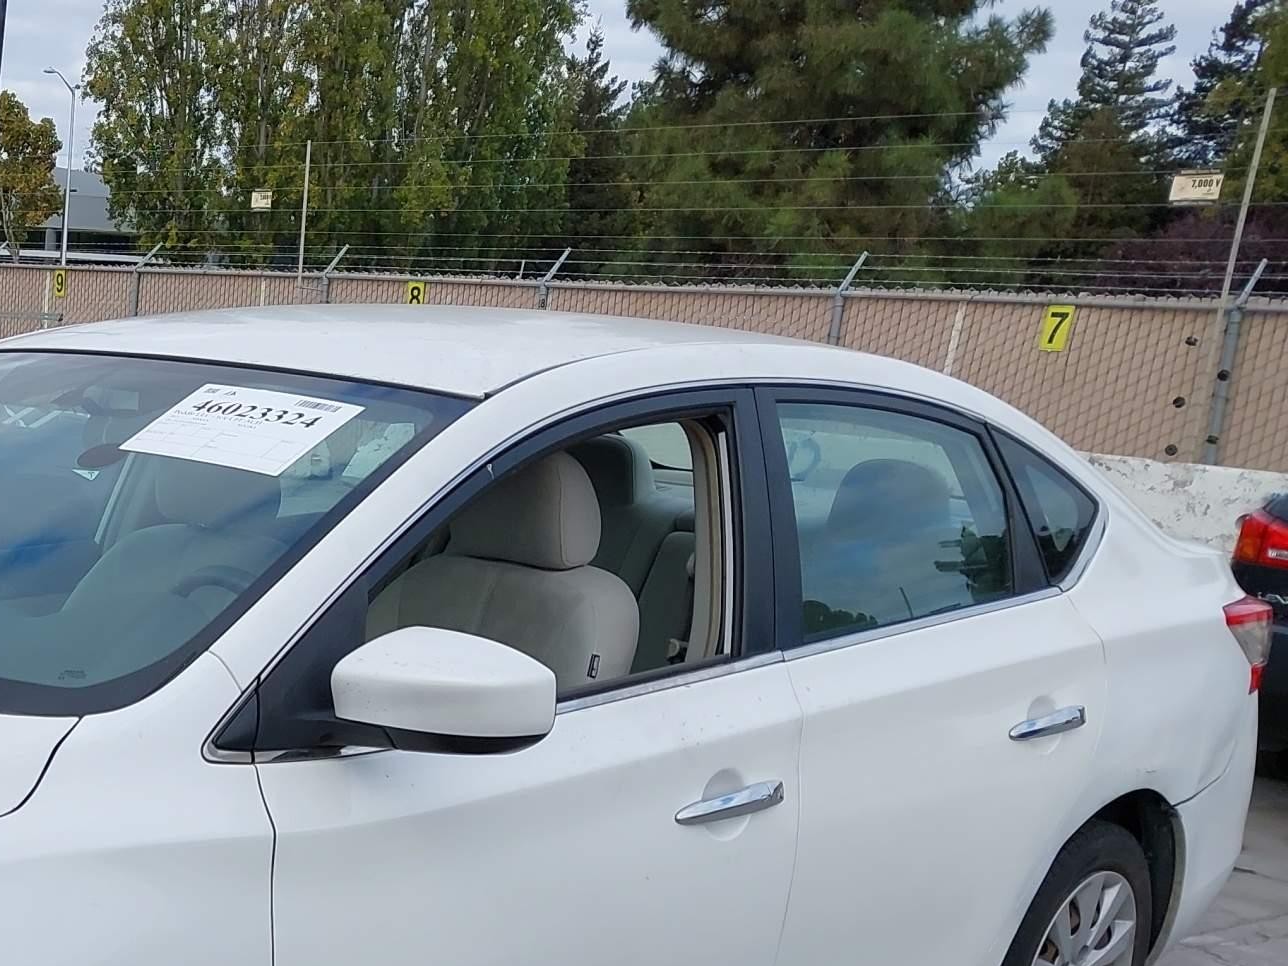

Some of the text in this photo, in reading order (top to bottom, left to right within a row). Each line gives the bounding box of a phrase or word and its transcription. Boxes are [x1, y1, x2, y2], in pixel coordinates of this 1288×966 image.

[1192, 179, 1214, 189] 7,000
[56, 273, 64, 293] 9
[408, 286, 421, 304] 8
[1046, 311, 1070, 345] 7
[192, 399, 322, 428] 46023324
